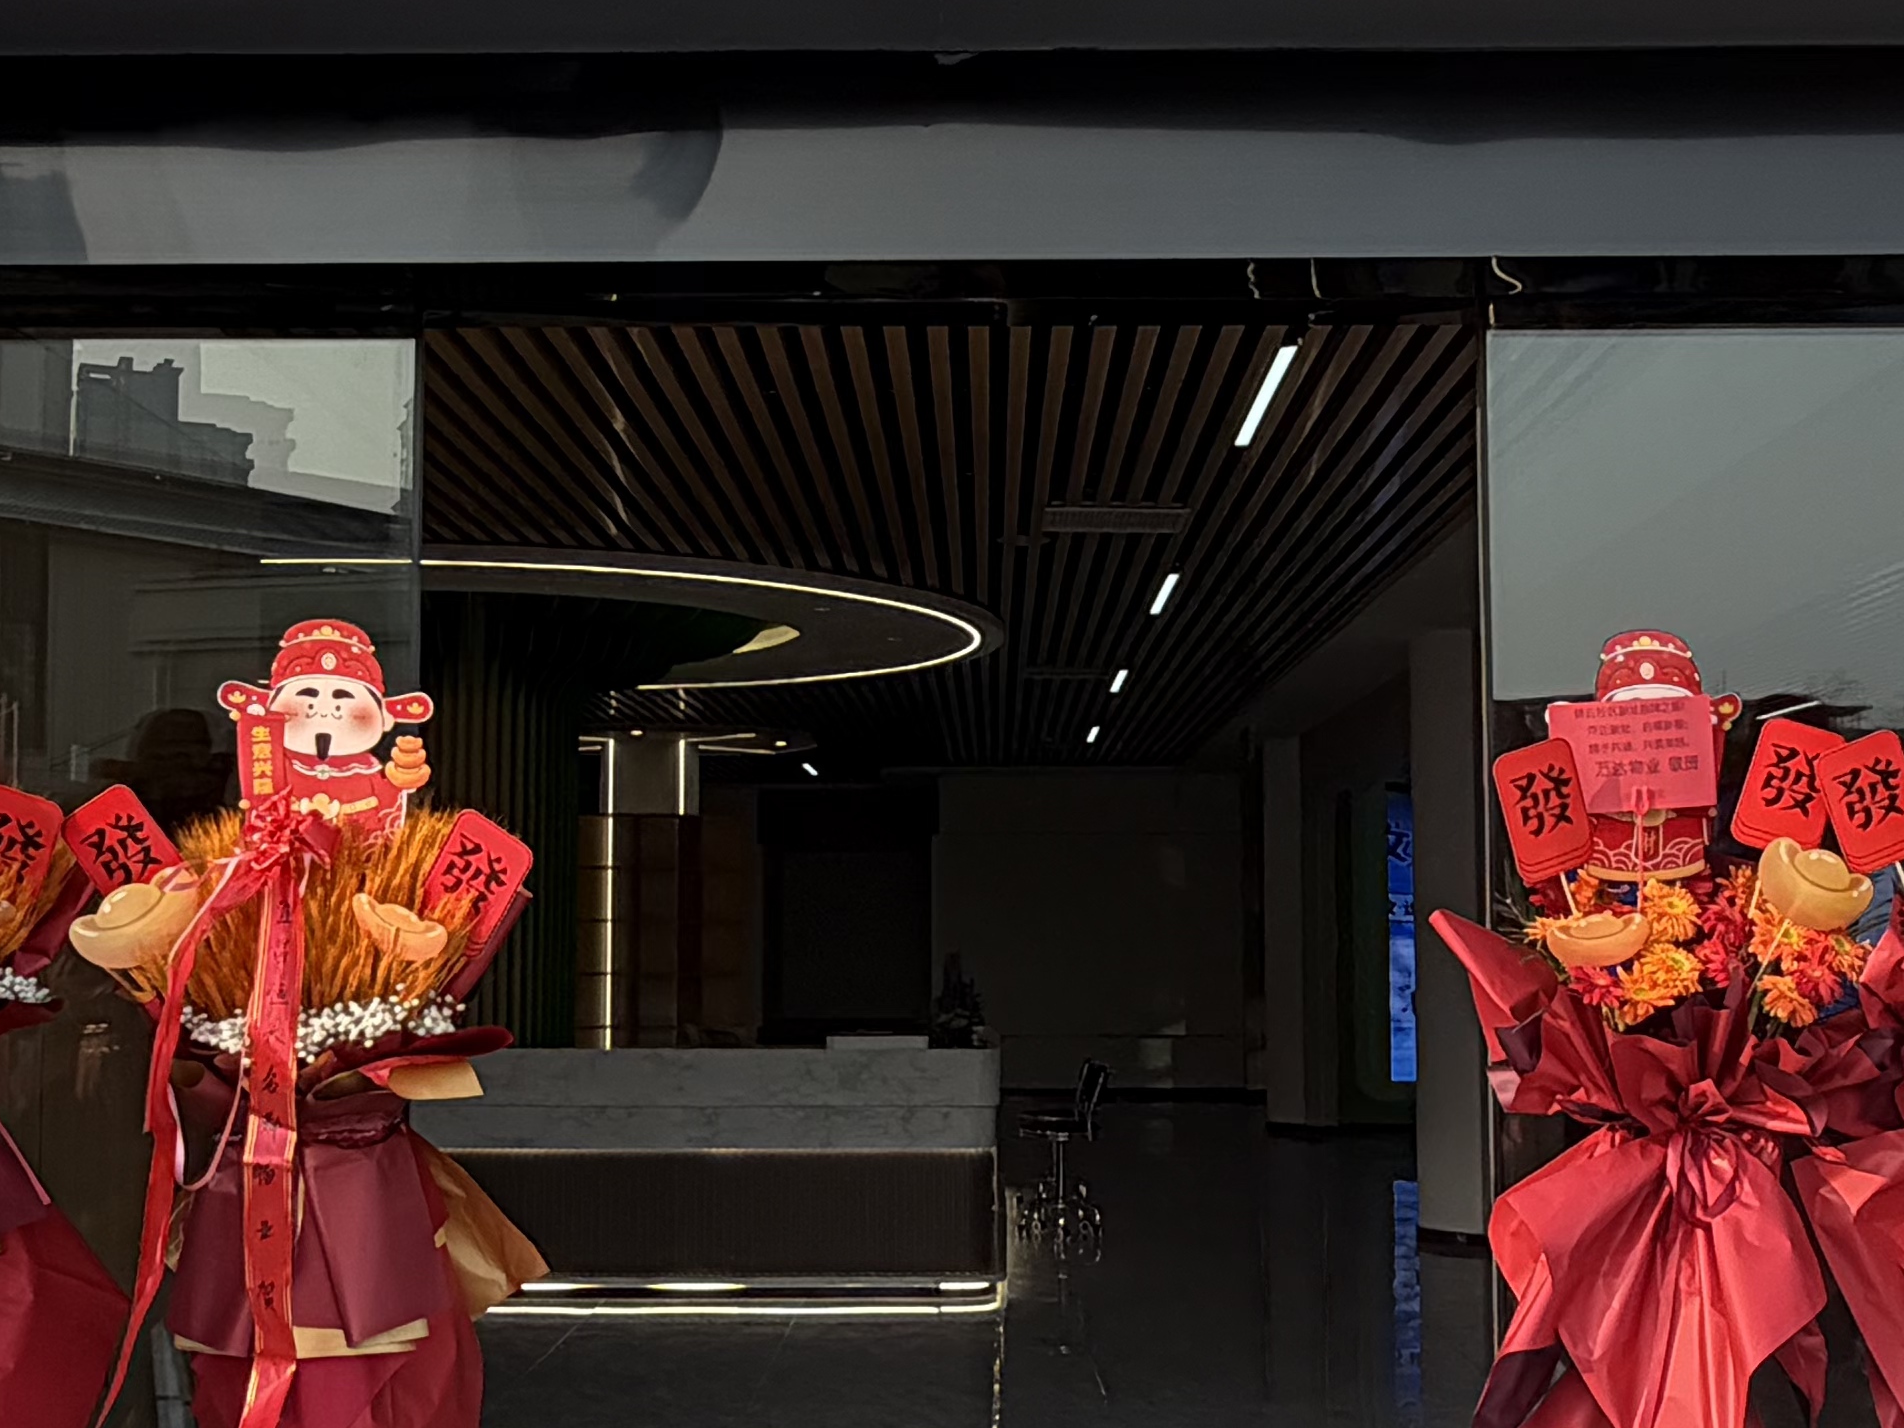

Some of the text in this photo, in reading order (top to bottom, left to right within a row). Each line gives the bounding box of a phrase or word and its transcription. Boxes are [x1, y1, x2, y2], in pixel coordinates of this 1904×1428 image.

[251, 725, 274, 795] 生意兴隆
[1760, 743, 1822, 819] 發
[1832, 756, 1904, 832] 發
[1509, 763, 1574, 839] 發
[80, 813, 163, 889] 發
[440, 832, 507, 915] 發
